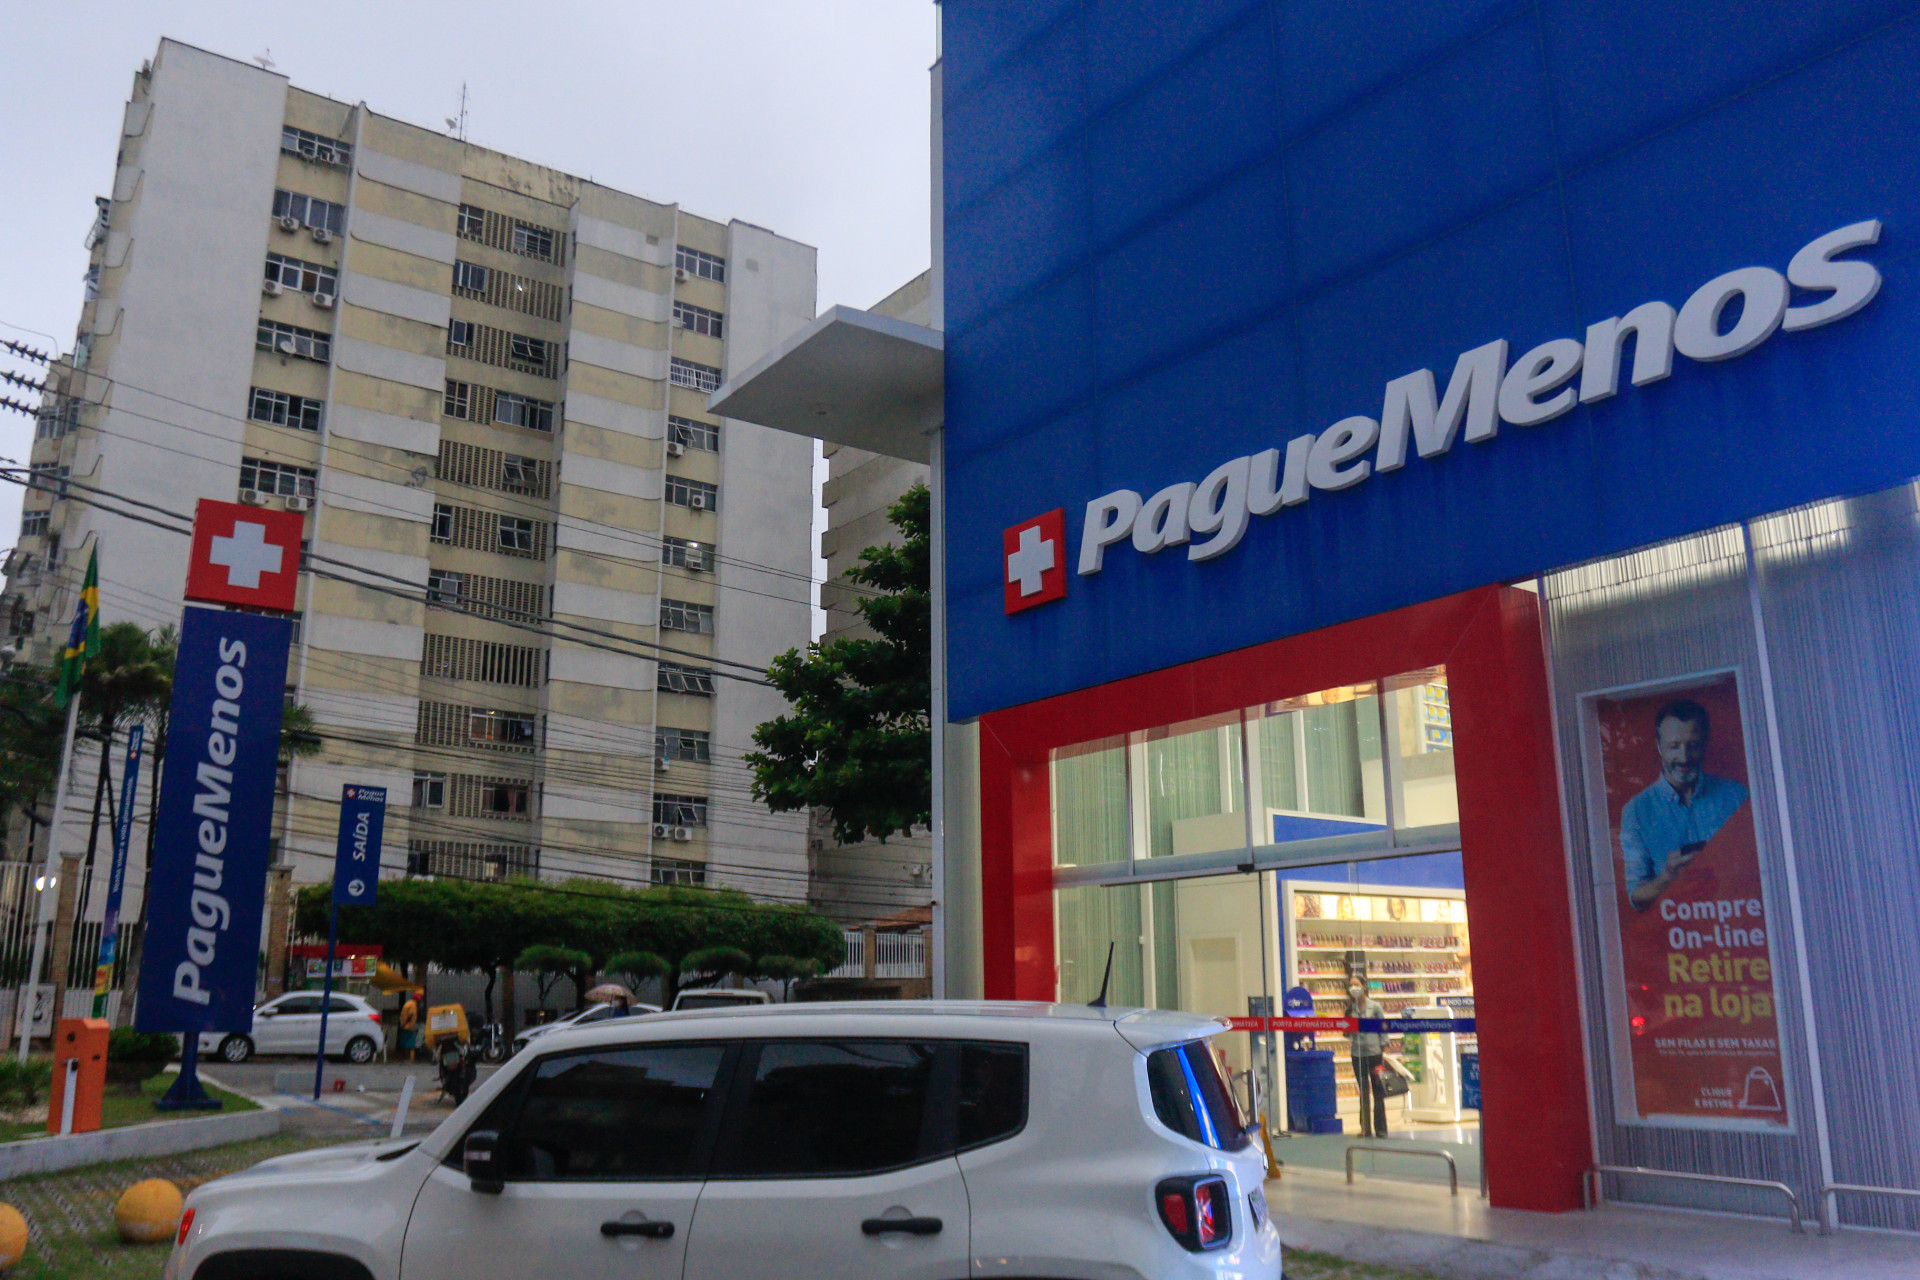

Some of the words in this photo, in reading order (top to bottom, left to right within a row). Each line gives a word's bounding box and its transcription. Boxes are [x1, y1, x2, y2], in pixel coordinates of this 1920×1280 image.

[1077, 219, 1882, 576] PagueMenos
[173, 637, 247, 1005] PagueMenos
[352, 812, 371, 862] SAÍDA
[1660, 897, 1763, 923] Compre
[1668, 925, 1765, 949] On-line
[1667, 951, 1771, 984] Retire
[1664, 993, 1704, 1018] na
[1709, 985, 1773, 1025] loja
[1272, 1021, 1293, 1029] PORTA
[1294, 1020, 1335, 1029] AUTOMÁTICA
[1655, 1037, 1676, 1048] SEM
[1717, 1037, 1740, 1048] SEM
[1742, 1037, 1776, 1049] TAXAS
